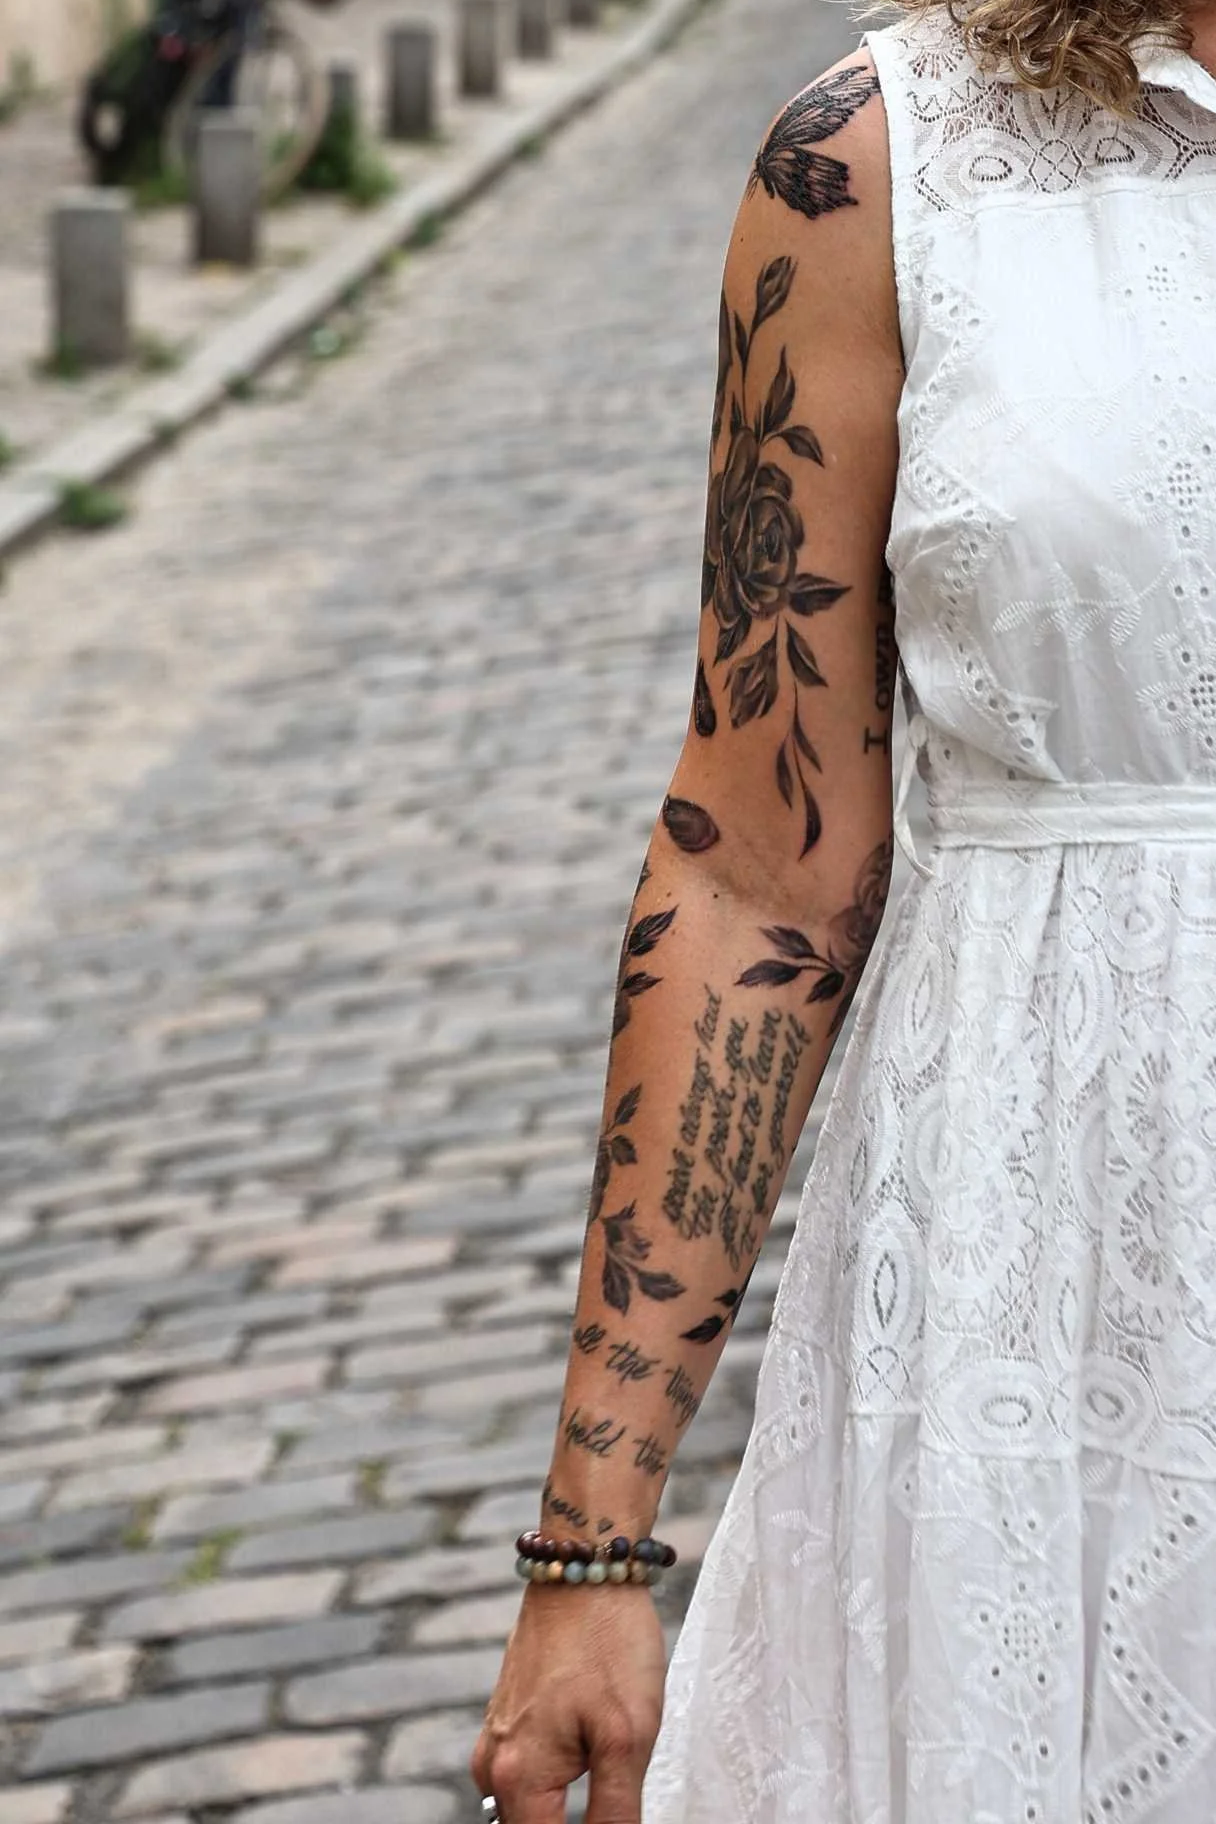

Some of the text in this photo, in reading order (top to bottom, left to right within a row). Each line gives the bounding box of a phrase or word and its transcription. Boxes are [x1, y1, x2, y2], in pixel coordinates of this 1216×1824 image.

[863, 727, 888, 754] I
[694, 982, 722, 1052] had
[749, 1007, 783, 1087] learn
[768, 1012, 811, 1173] yourself
